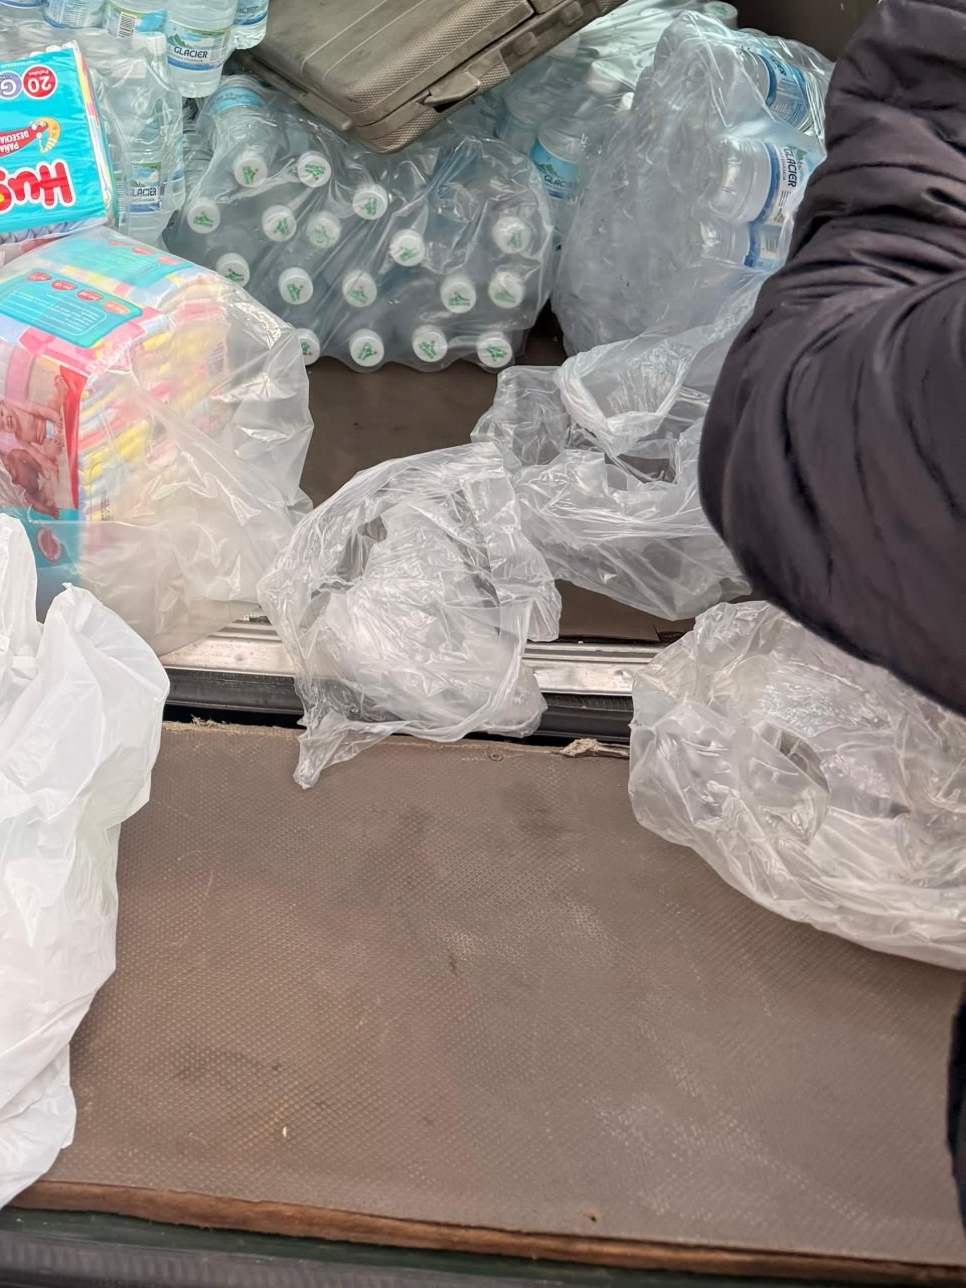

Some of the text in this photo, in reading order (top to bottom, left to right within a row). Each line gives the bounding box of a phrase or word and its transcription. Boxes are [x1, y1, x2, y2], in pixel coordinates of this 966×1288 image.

[174, 46, 208, 59] GLACIER
[0, 80, 17, 95] G
[27, 75, 51, 93] 20
[783, 148, 797, 188] GLACIER
